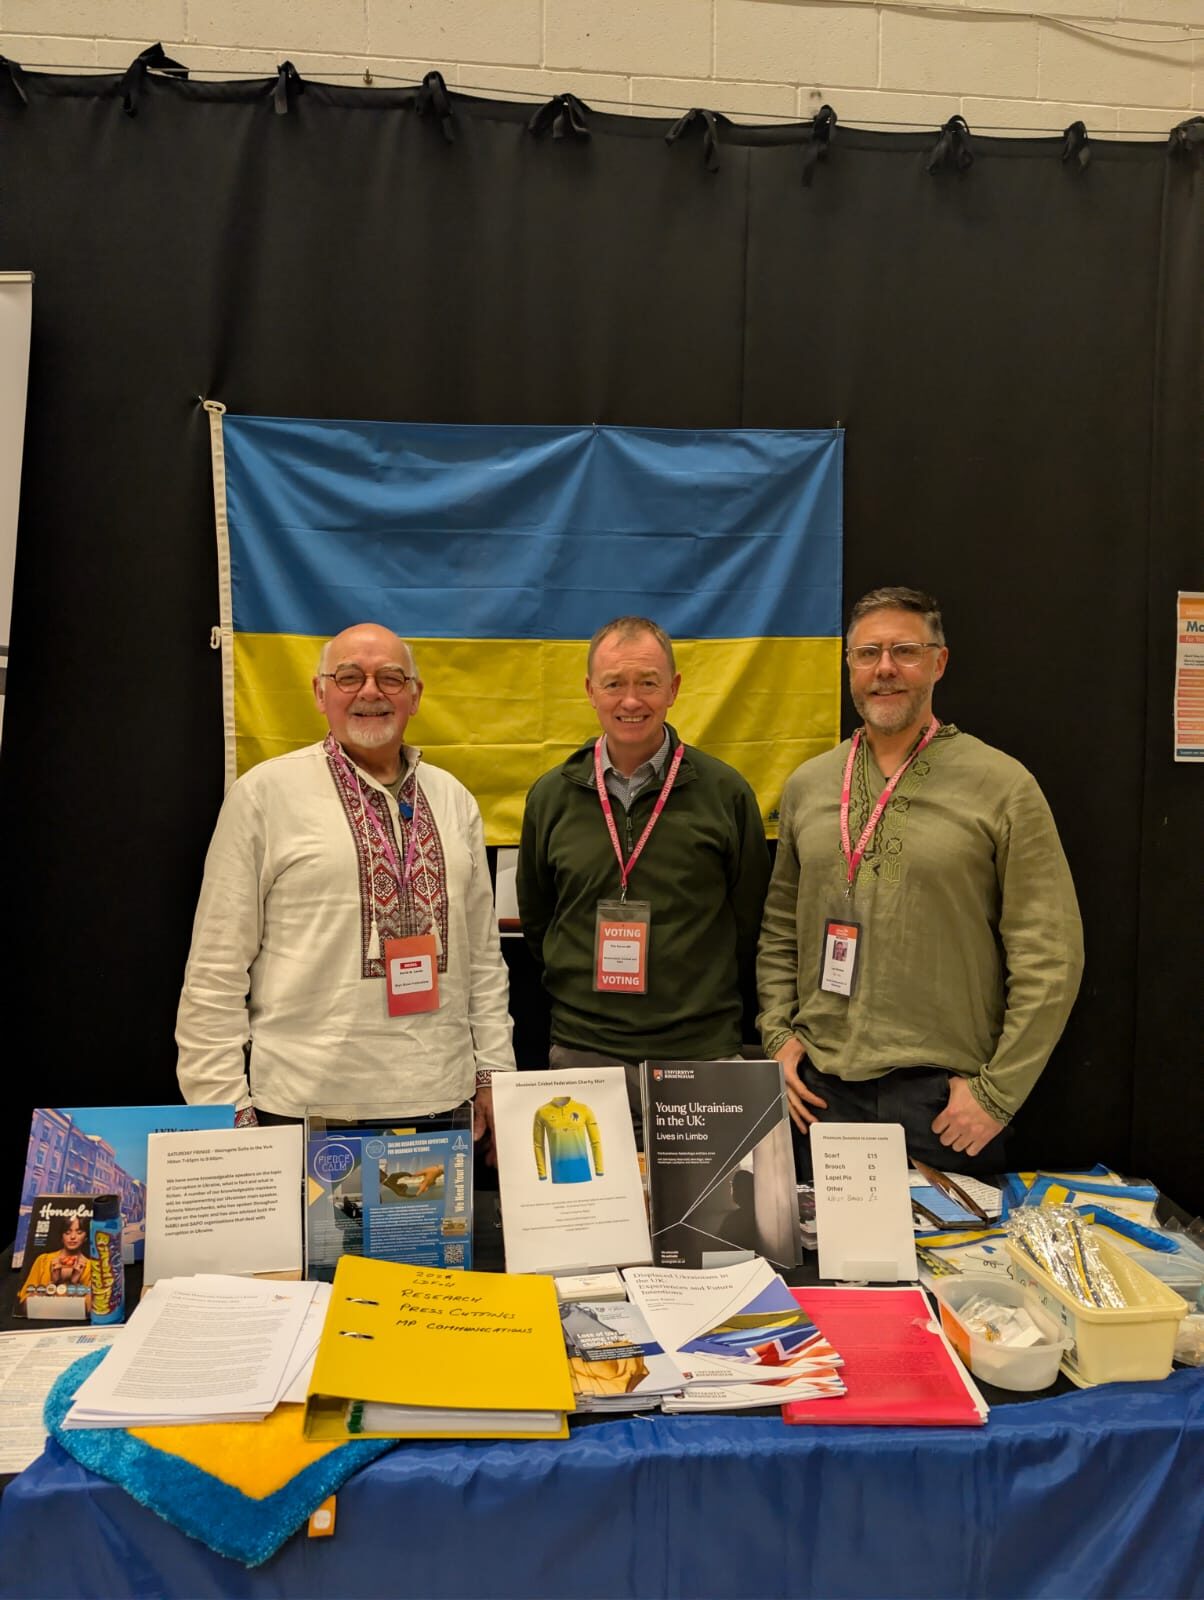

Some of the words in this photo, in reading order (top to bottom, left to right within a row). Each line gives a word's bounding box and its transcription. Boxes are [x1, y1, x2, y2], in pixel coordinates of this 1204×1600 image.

[856, 803, 883, 854] POLIMONITOR
[604, 928, 641, 937] VOTING
[602, 976, 640, 985] VOTING
[655, 1101, 688, 1116] Young
[688, 1102, 744, 1113] Ukrainians
[656, 1115, 666, 1126] in
[667, 1115, 685, 1126] the
[686, 1115, 705, 1126] UK:
[656, 1132, 676, 1140] Lives
[676, 1132, 684, 1140] in
[685, 1132, 708, 1140] Limbo
[318, 1153, 350, 1164] FIERCE
[453, 1152, 467, 1168] Help
[321, 1162, 347, 1172] CALM
[453, 1169, 464, 1184] Your
[454, 1184, 464, 1201] Need
[401, 1288, 482, 1303] RESEARCH
[400, 1303, 443, 1315] PRESS
[396, 1319, 417, 1327] MP
